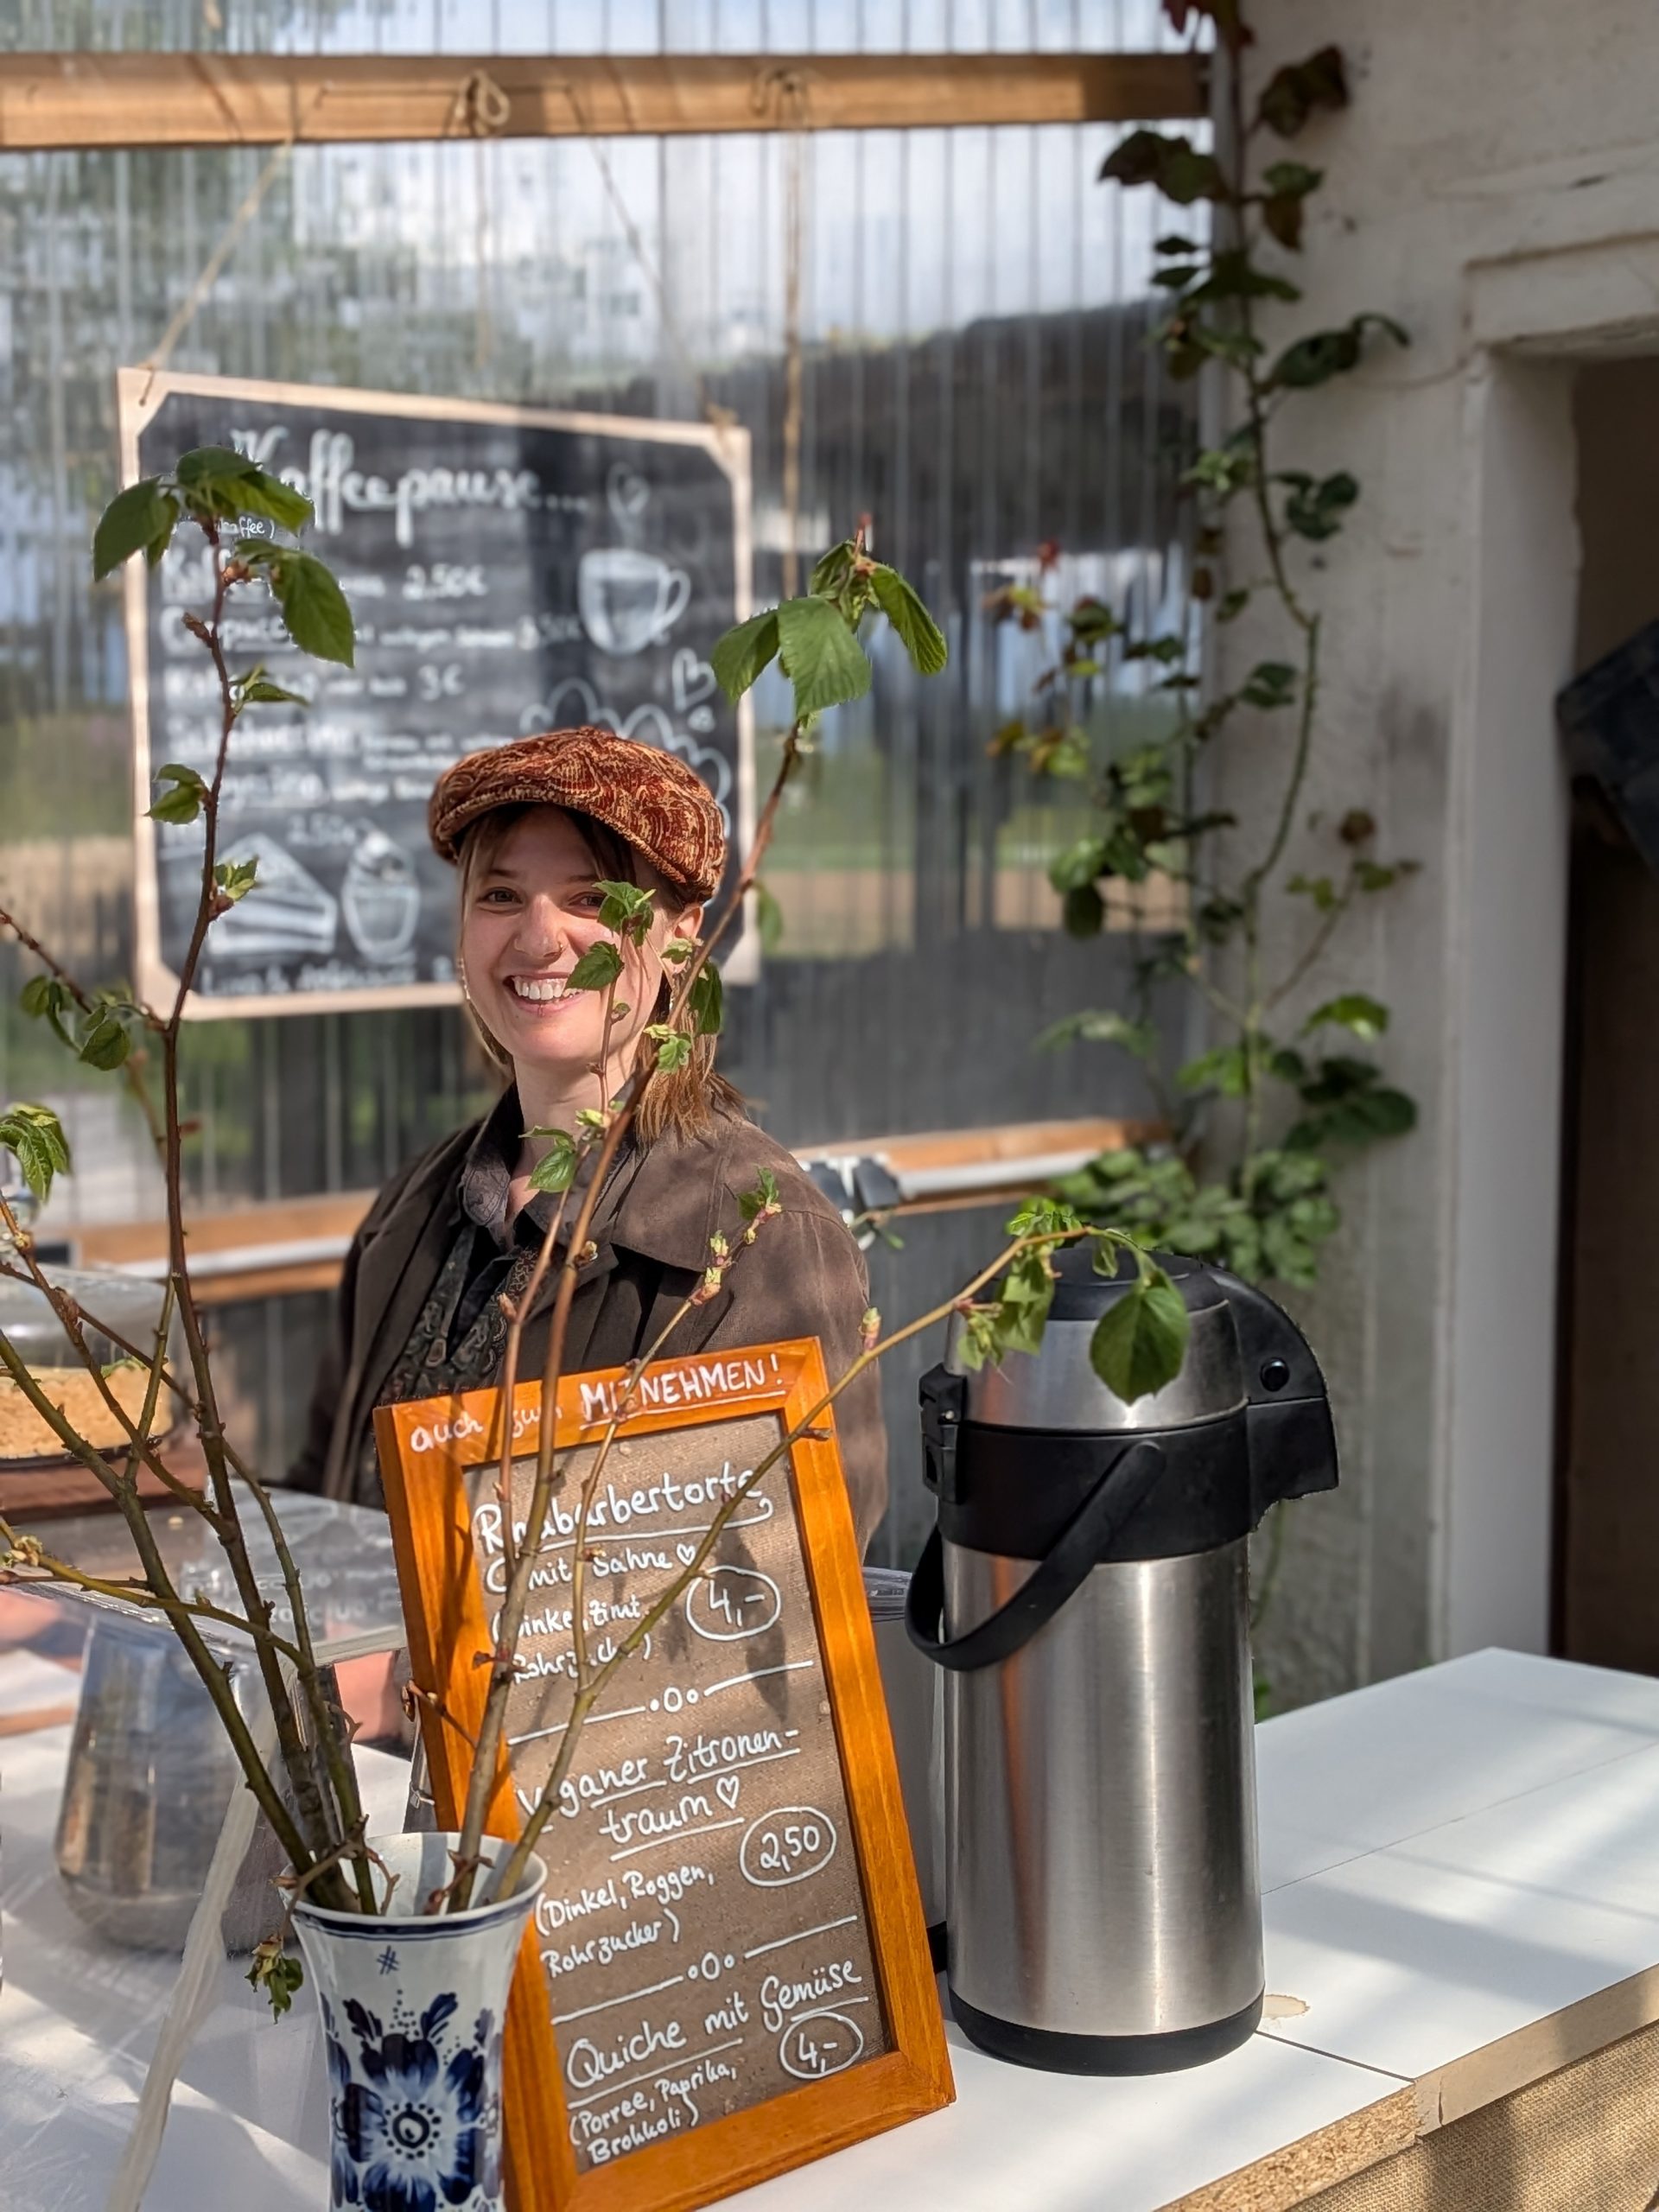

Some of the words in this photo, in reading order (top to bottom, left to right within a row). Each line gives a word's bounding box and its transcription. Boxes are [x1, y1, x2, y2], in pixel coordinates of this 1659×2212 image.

[410, 1410, 484, 1453] auch
[512, 1406, 563, 1439] zu
[528, 1556, 573, 1591] mit
[709, 1579, 766, 1627] 4,-
[518, 1758, 648, 1819] Vganer
[663, 1730, 799, 1782] Zitronen-
[599, 1795, 713, 1844] traum
[760, 1825, 820, 1872] 2,50
[534, 1878, 627, 1936] (Dinkel,
[621, 1866, 714, 1904] Roggen,
[567, 2021, 687, 2088] Quiche
[704, 1991, 749, 2034] mit
[760, 1960, 862, 2033] Gemüse
[798, 2032, 838, 2073] 4,-
[569, 2091, 656, 2146] (Porree,
[654, 2059, 737, 2101] Paprika,
